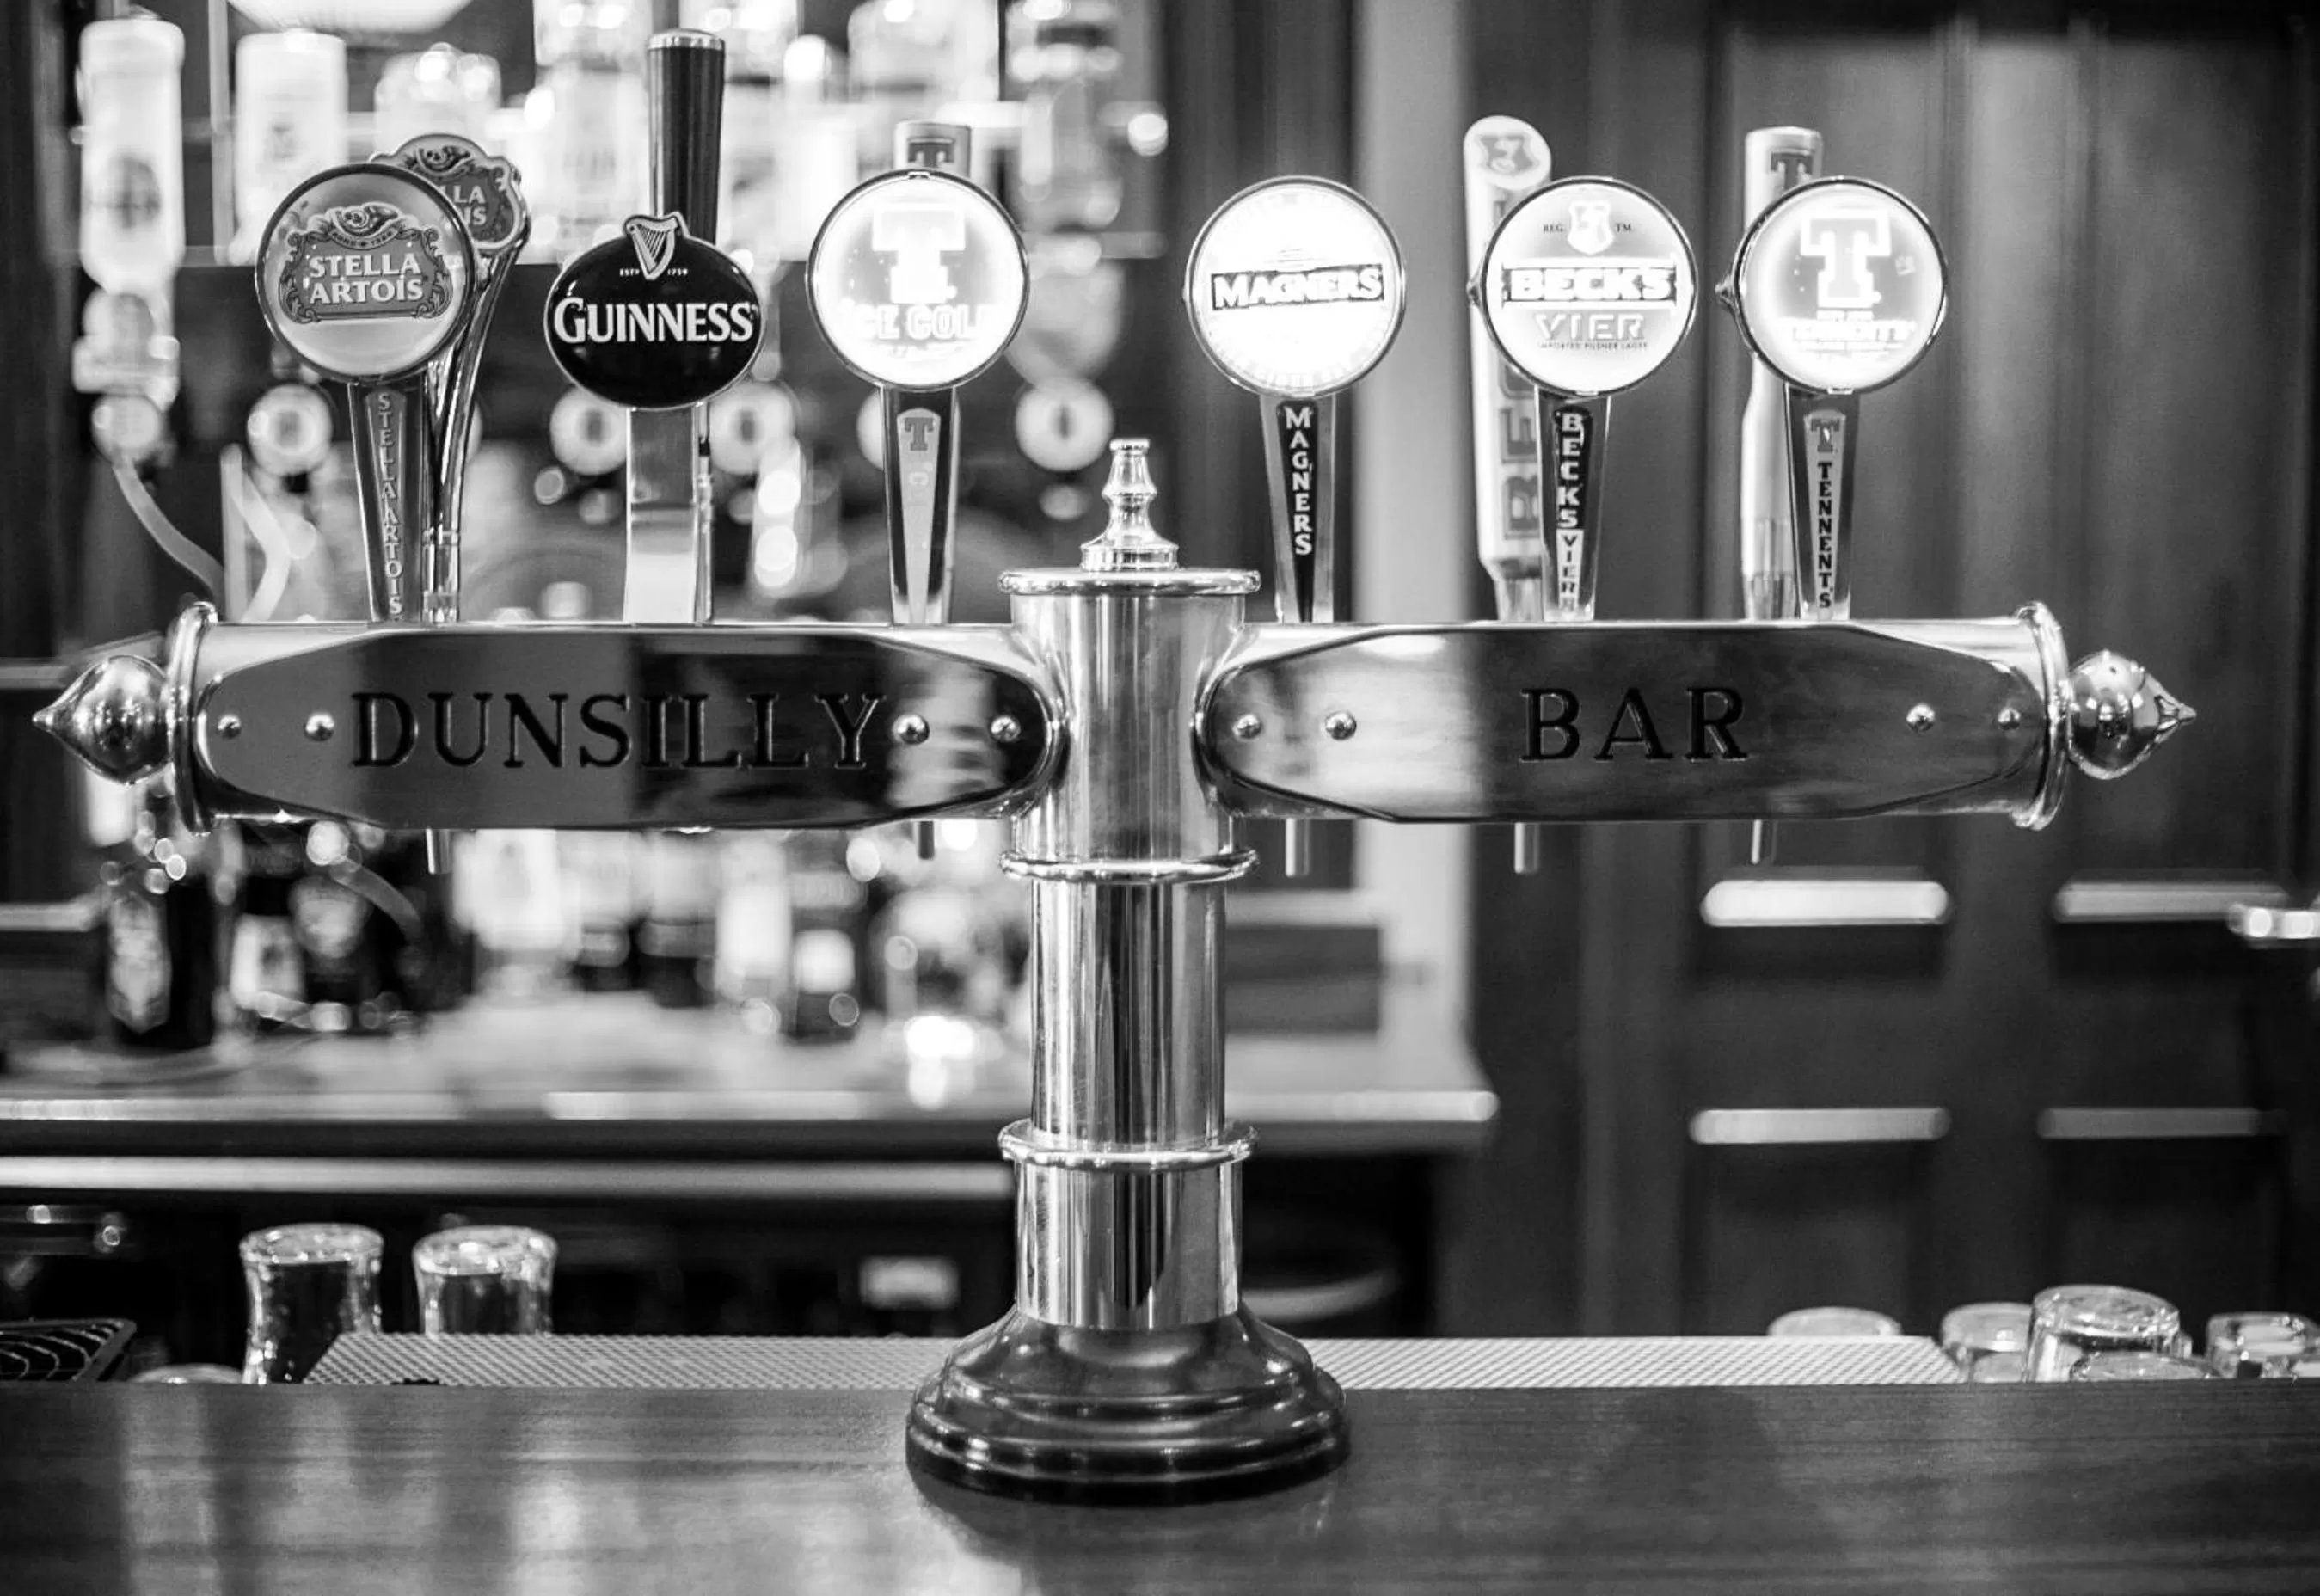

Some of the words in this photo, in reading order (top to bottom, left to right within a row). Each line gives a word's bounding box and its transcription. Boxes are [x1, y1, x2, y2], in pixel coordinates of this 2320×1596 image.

[310, 252, 422, 279] STELLA
[1801, 210, 1890, 309] T
[310, 278, 424, 304] ARTOIS
[1215, 268, 1382, 308] MAGNERS
[554, 296, 754, 344] GUINNESS
[1534, 312, 1645, 341] VIER
[378, 393, 396, 500] STELLA
[904, 416, 934, 451] T
[1811, 418, 1840, 453] T
[1285, 406, 1313, 555] MAGNERS
[384, 506, 402, 614] ARTOIS
[350, 691, 887, 769] DUNSILLY
[1519, 687, 1749, 762] BAR
